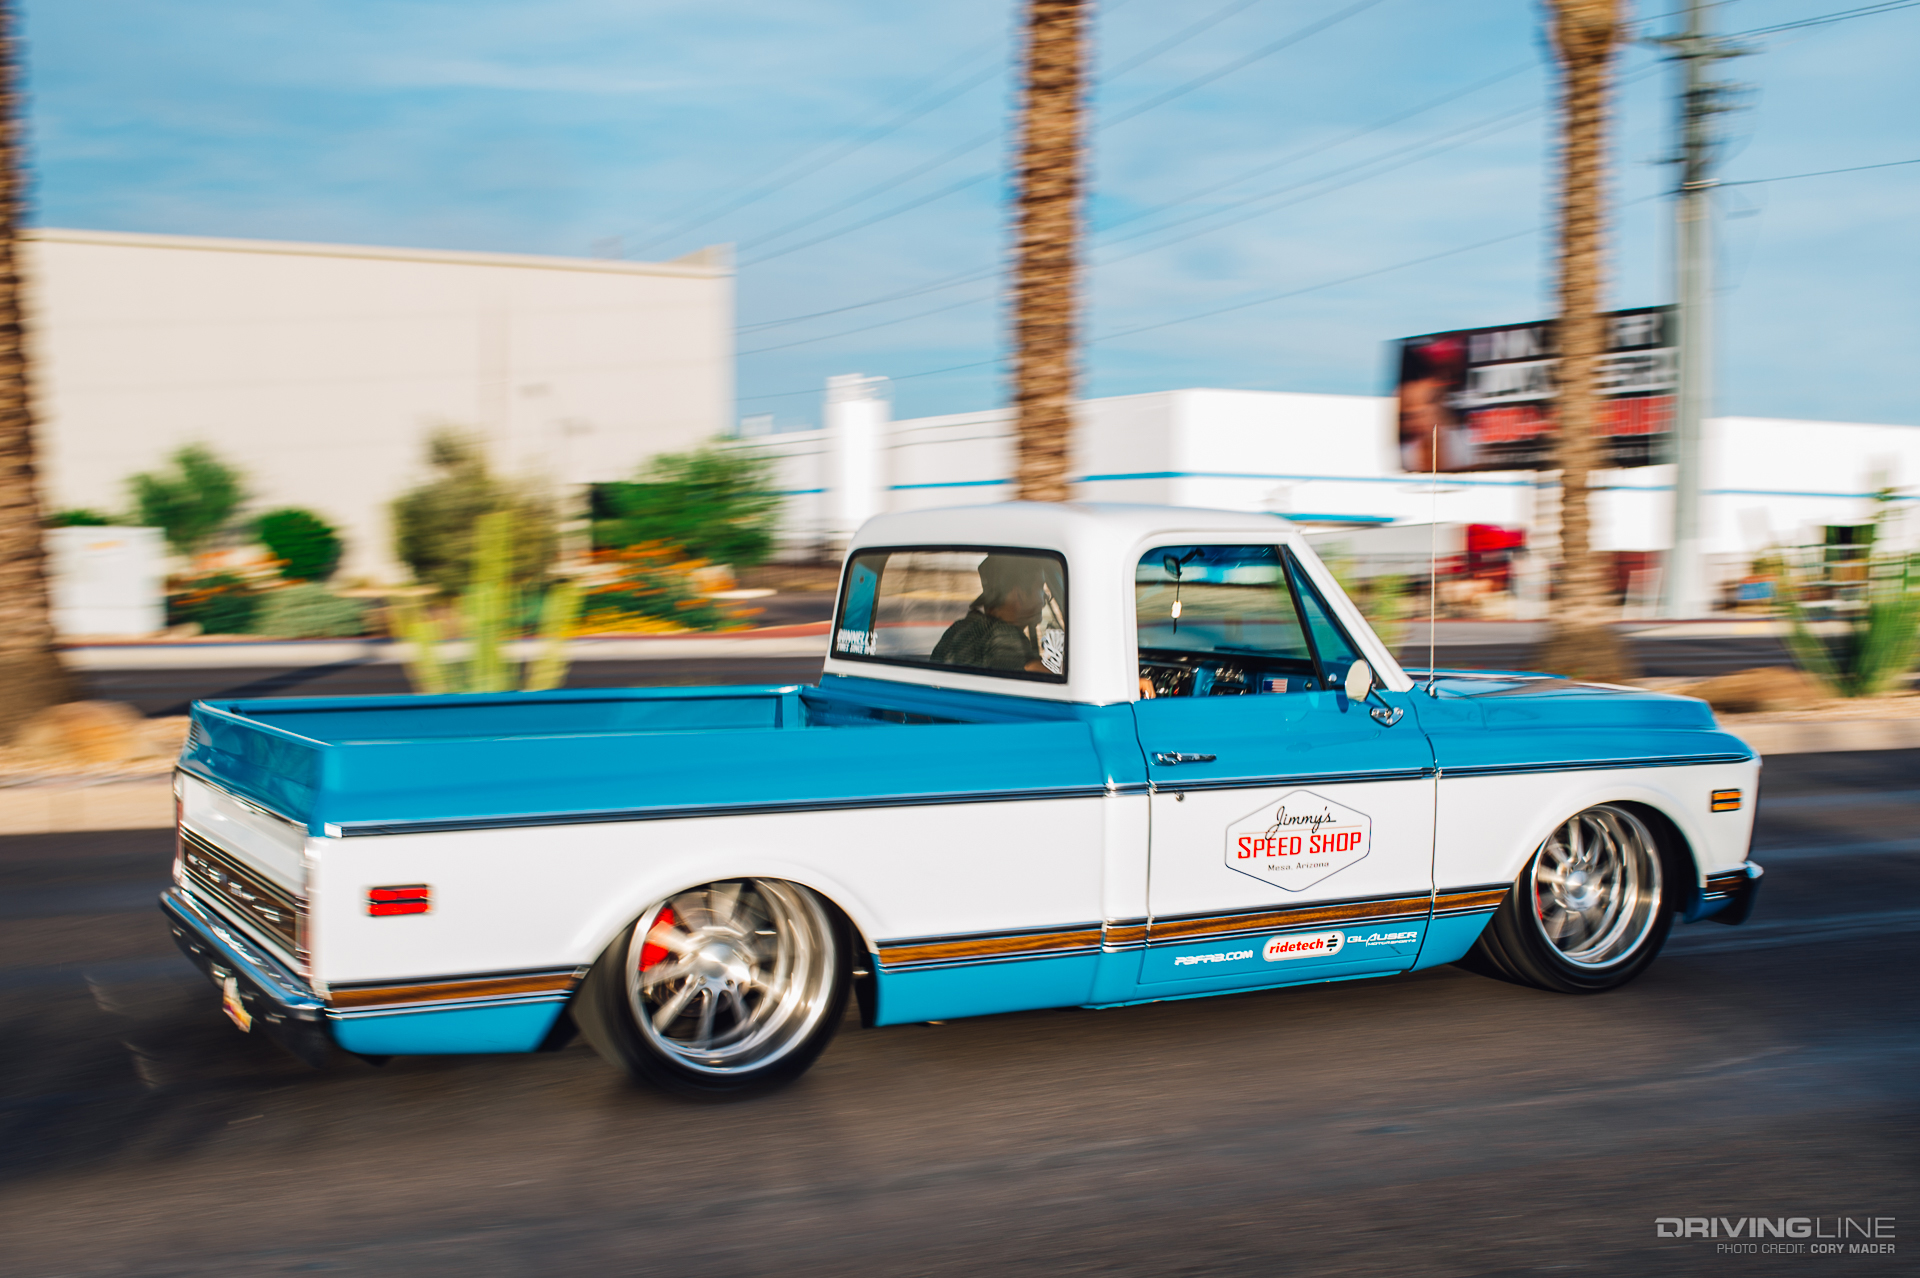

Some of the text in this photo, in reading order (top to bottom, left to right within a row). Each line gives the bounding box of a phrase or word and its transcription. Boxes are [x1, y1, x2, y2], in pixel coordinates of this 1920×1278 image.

[1265, 805, 1337, 840] Jimmy's
[1237, 831, 1362, 859] SPEED SHOP
[1296, 861, 1330, 870] Arizona
[1269, 938, 1324, 954] ridetech
[1346, 931, 1418, 947] GLAUSER
